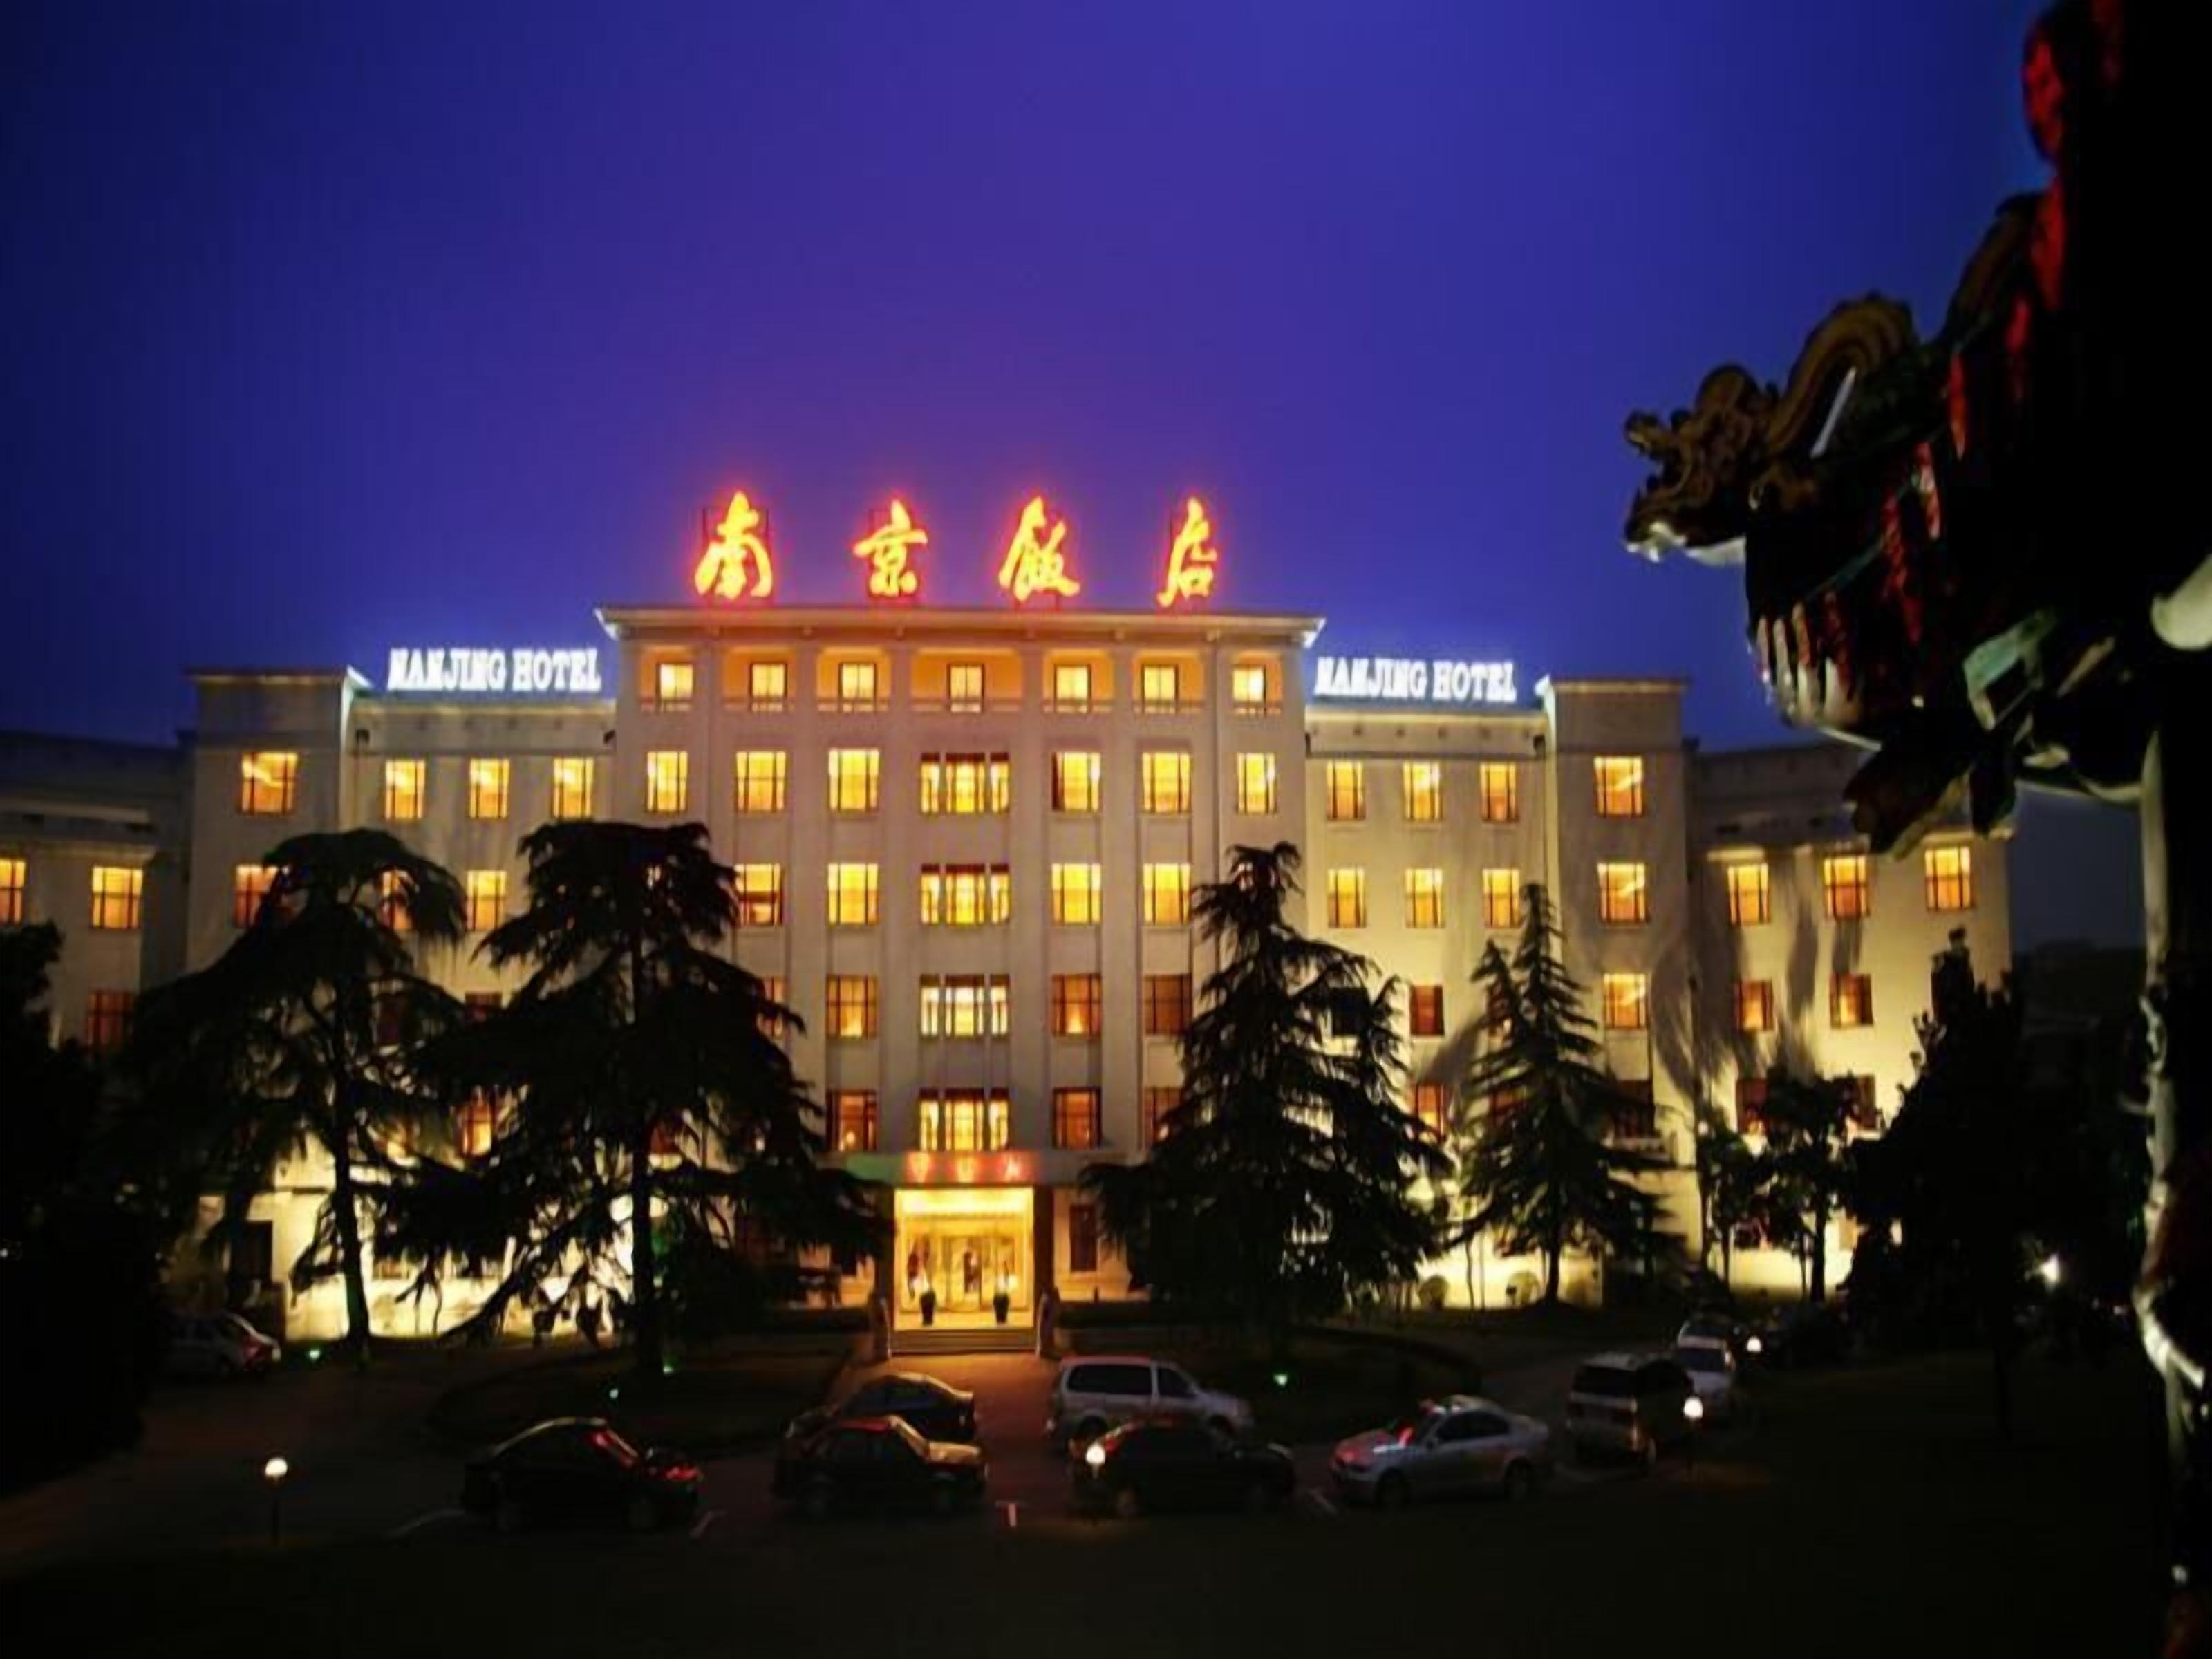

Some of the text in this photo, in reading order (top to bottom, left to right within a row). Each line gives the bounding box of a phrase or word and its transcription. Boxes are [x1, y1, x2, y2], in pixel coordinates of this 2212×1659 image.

[387, 647, 602, 691] NANJING HOTEL
[1313, 657, 1517, 702] NANJING HOTEL
